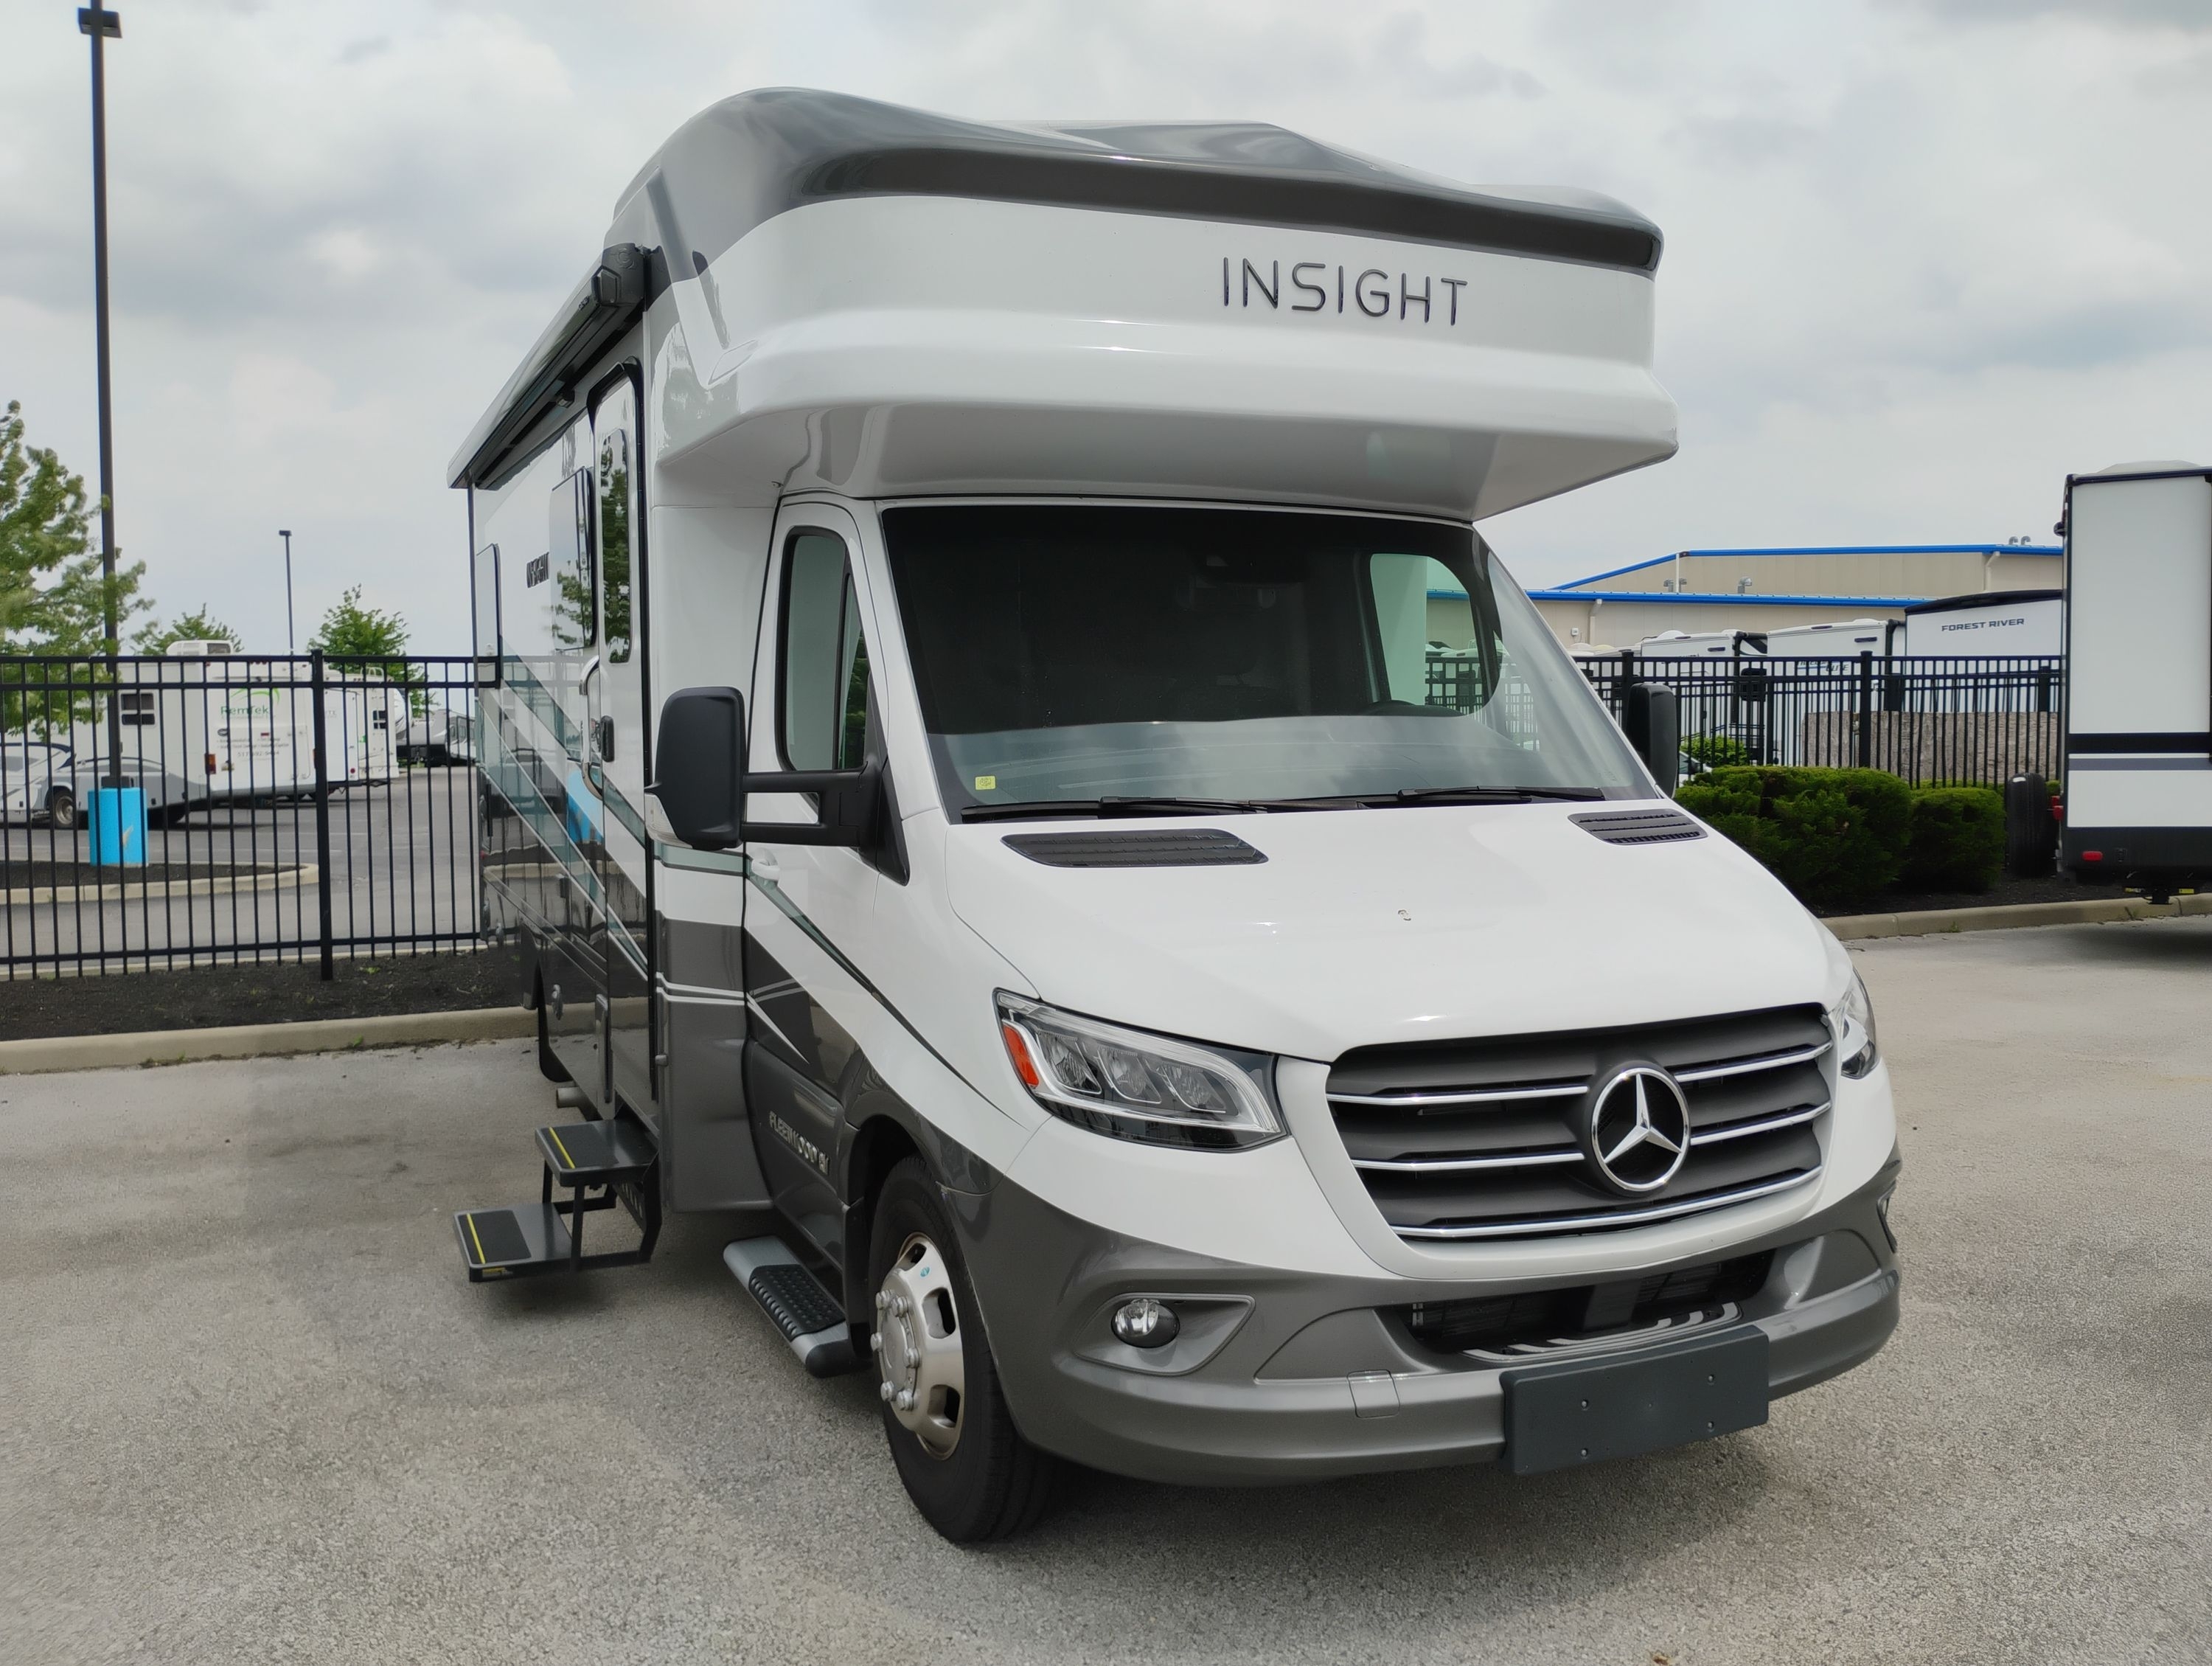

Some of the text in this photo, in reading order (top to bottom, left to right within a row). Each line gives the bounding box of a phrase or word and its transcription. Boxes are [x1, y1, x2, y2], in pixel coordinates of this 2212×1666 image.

[1223, 257, 1468, 326] INSIGHT
[1941, 618, 2025, 632] FOREST RIVER
